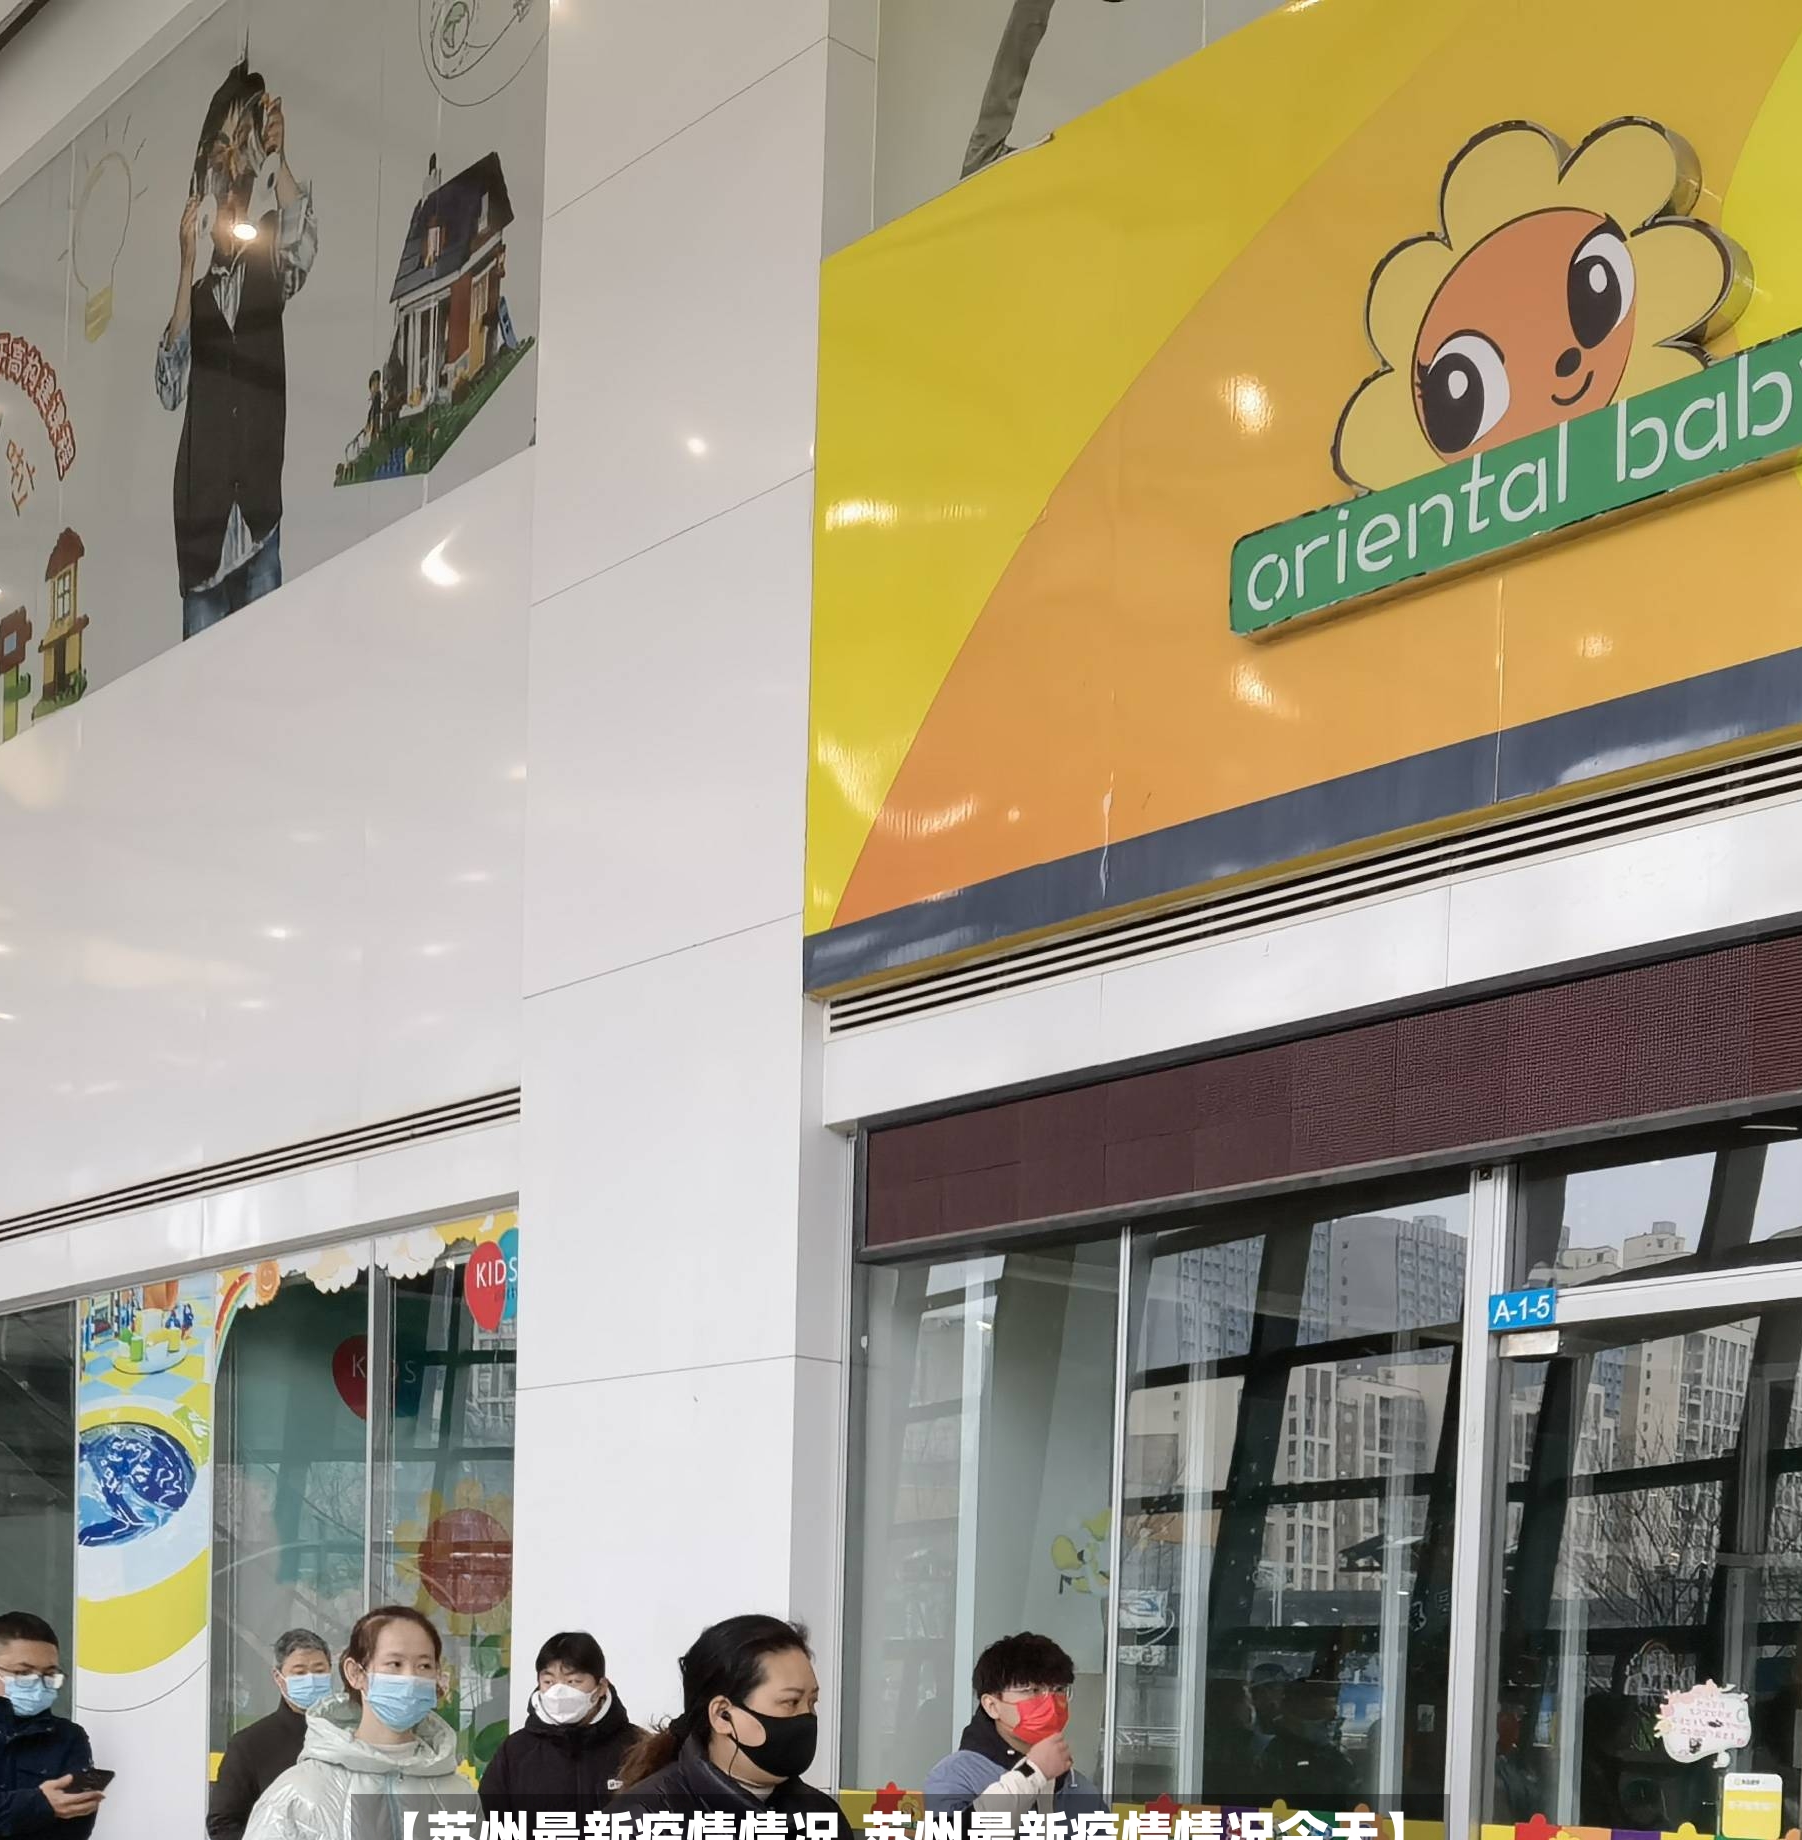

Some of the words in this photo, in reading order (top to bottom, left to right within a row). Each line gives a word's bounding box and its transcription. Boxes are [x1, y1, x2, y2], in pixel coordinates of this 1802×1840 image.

[1245, 424, 1570, 612] oriental
[476, 1257, 517, 1288] KIDS
[1492, 1295, 1551, 1325] A-1-5
